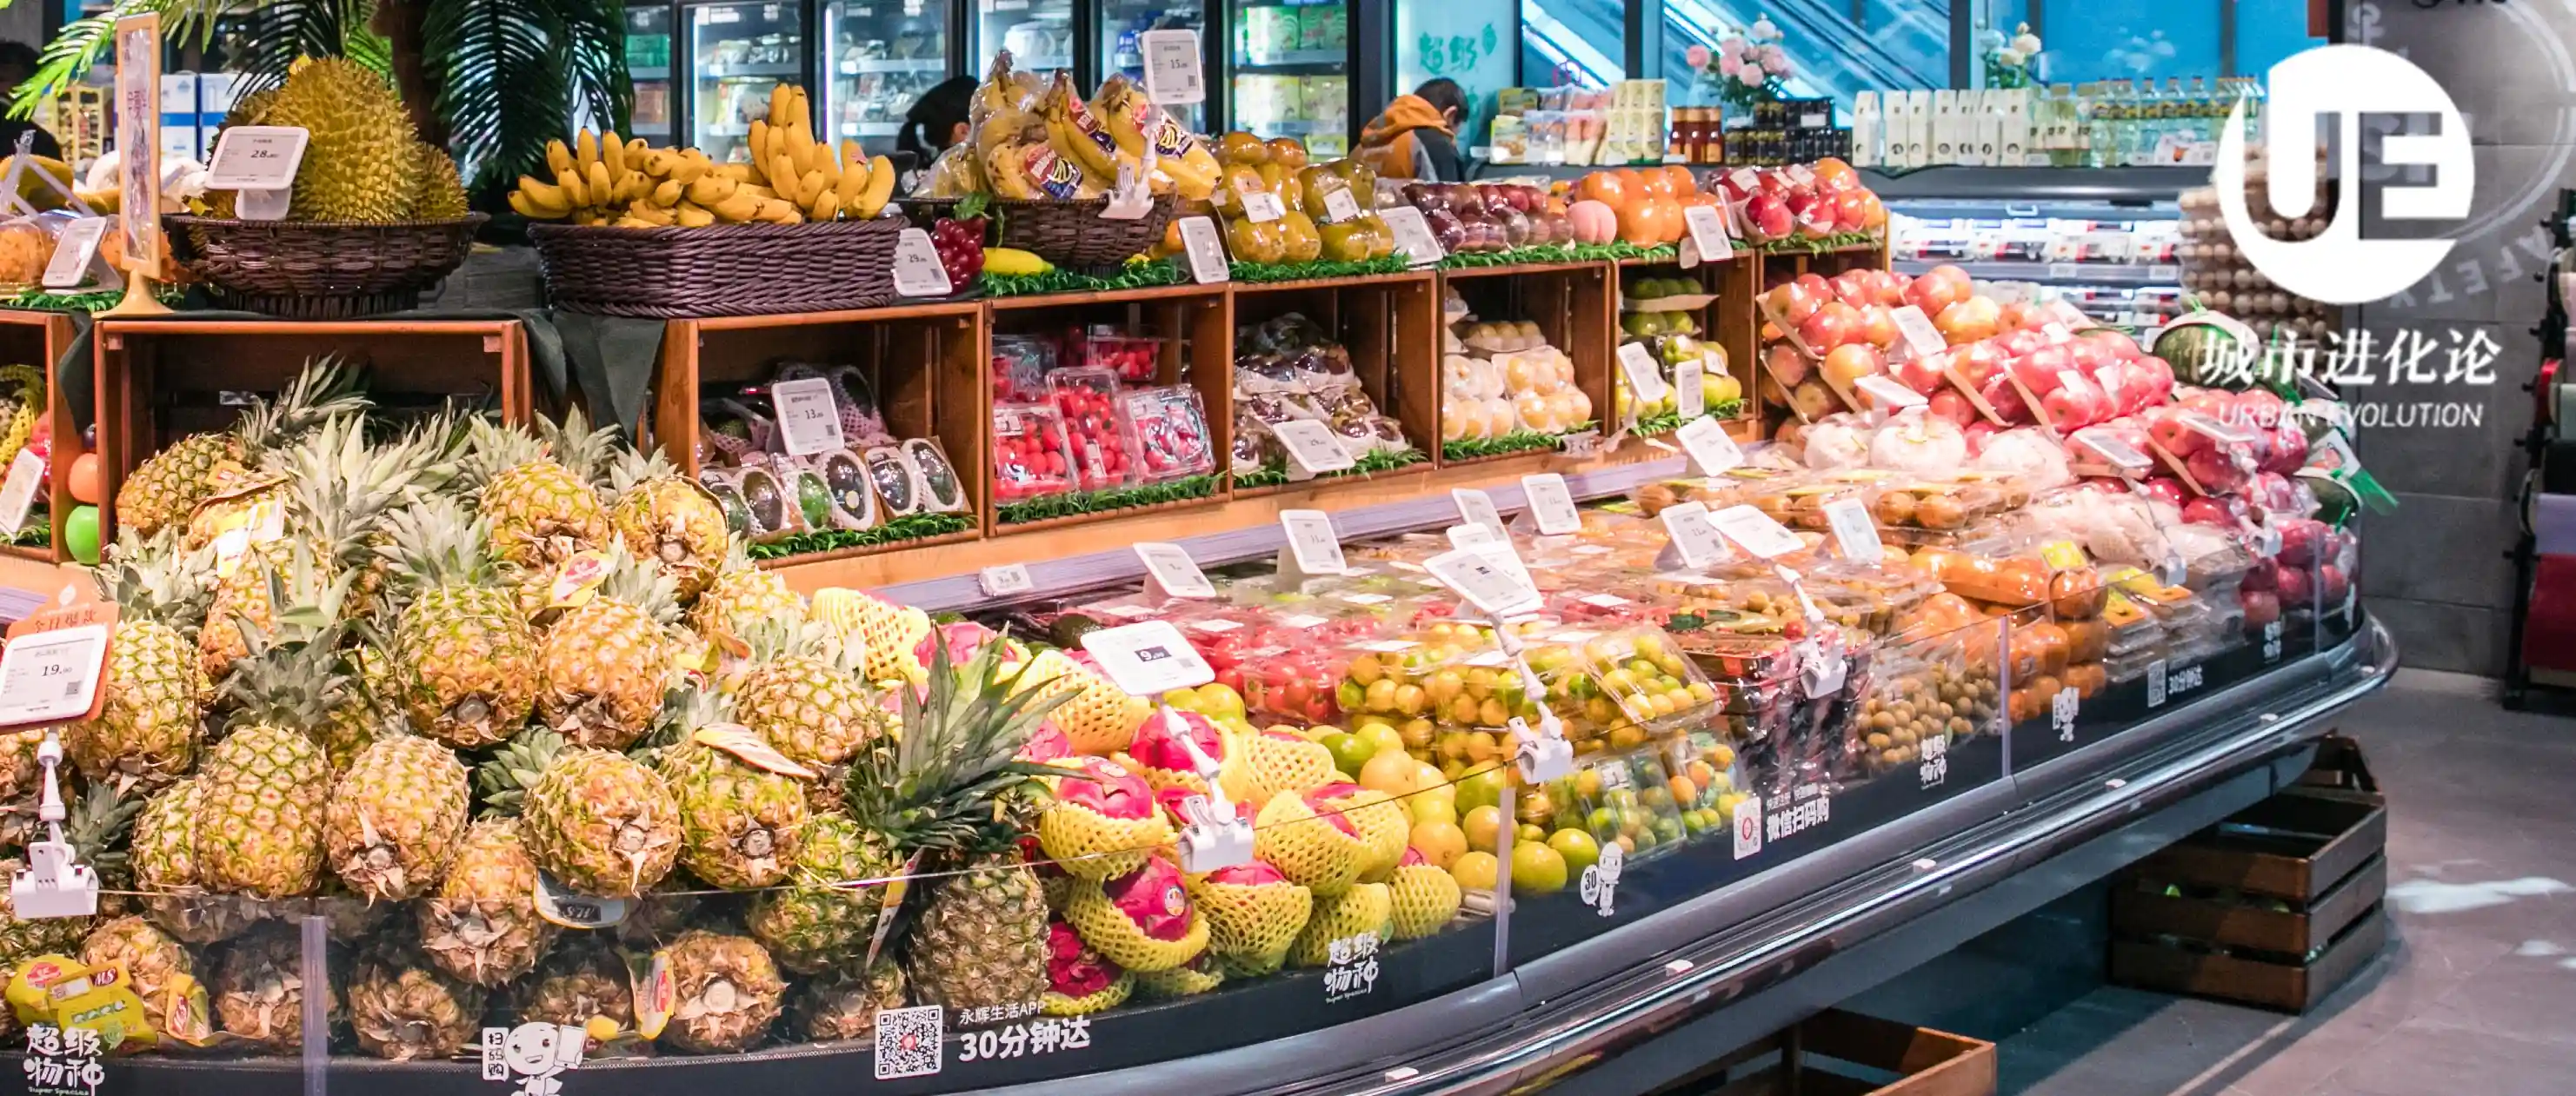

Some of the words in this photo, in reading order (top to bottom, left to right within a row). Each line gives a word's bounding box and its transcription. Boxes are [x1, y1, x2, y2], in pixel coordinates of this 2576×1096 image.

[2390, 224, 2553, 309] AFETY
[1766, 795, 1830, 843] 微信扫码购
[1584, 870, 1597, 890] 30
[1327, 930, 1380, 968] 超级
[1323, 954, 1380, 997] 物种
[959, 1000, 1047, 1026] 永辉生活APP
[26, 1022, 103, 1057] 超级
[957, 1014, 1092, 1062] 30分钟达
[23, 1056, 105, 1096] 物种
